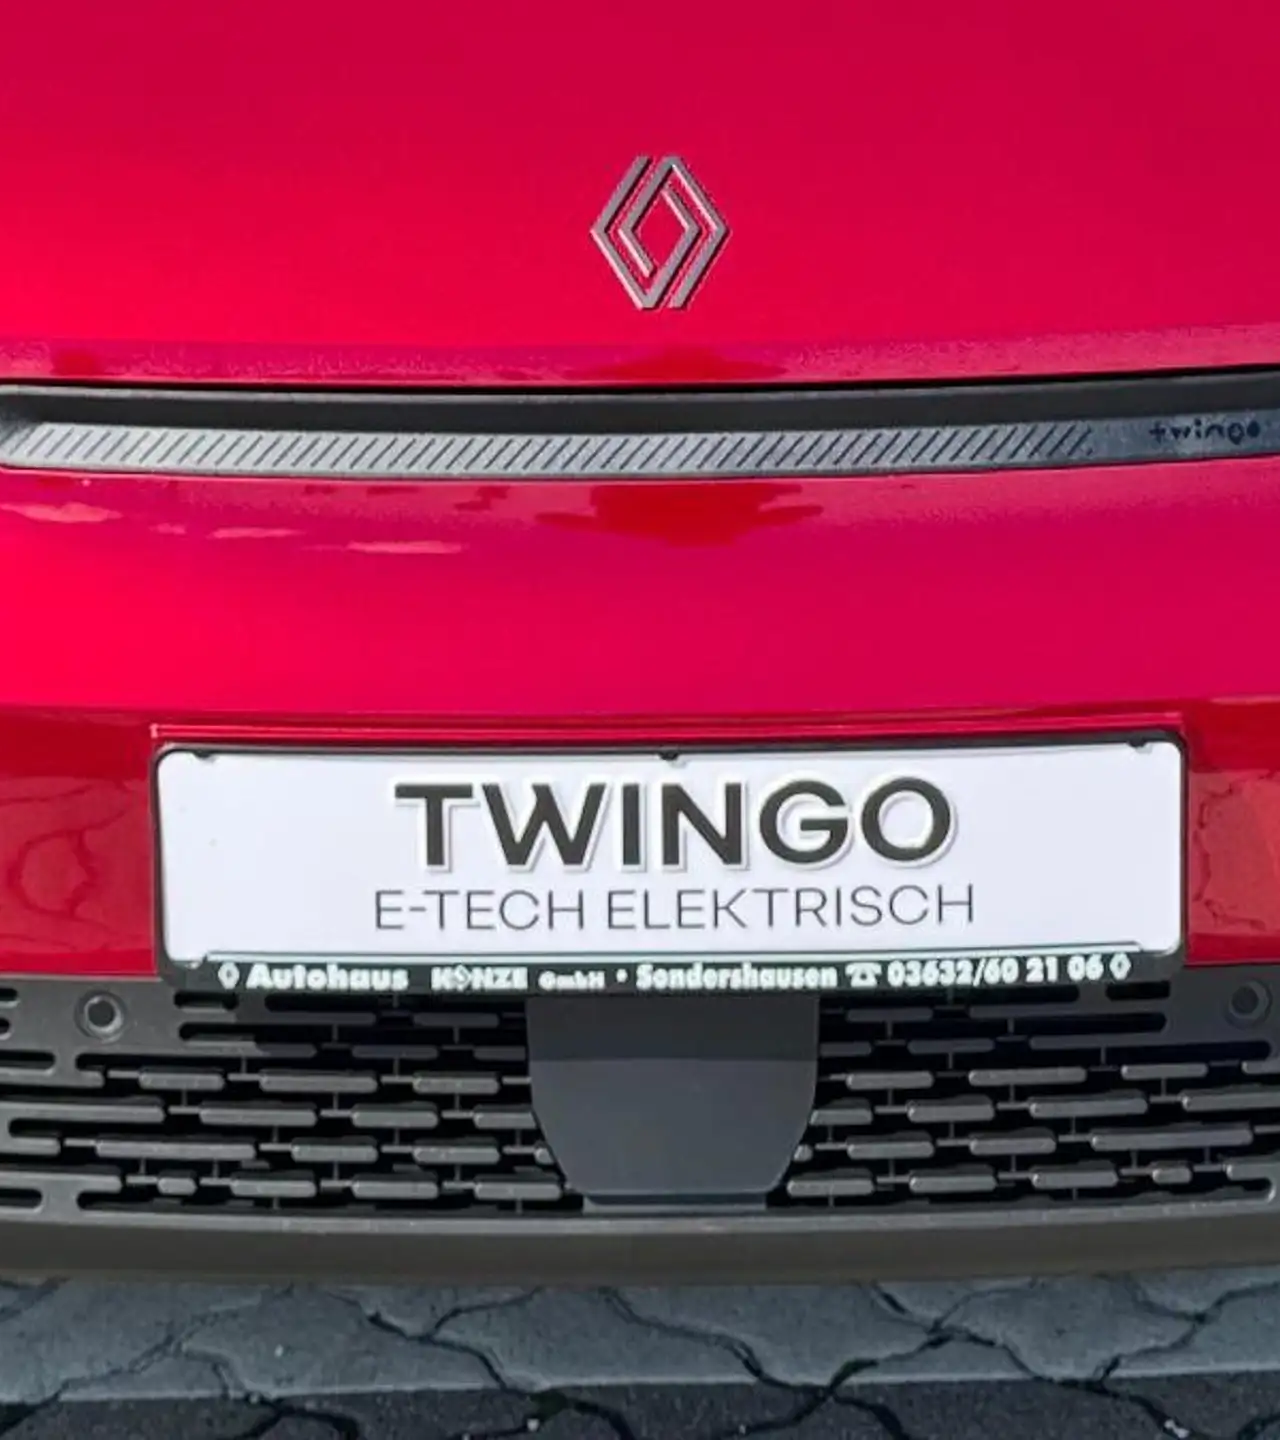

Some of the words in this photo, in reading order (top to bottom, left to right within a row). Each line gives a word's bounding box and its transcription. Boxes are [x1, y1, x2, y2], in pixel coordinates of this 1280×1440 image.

[394, 777, 952, 866] TWINGO
[375, 889, 584, 931] E-TECH
[607, 883, 974, 930] ELEKTRISCH
[246, 964, 408, 990] Autohaus
[635, 962, 838, 990] Sondershausen
[887, 956, 1018, 988] 03632/60
[1026, 955, 1060, 984] 21
[1067, 953, 1104, 983] 06
